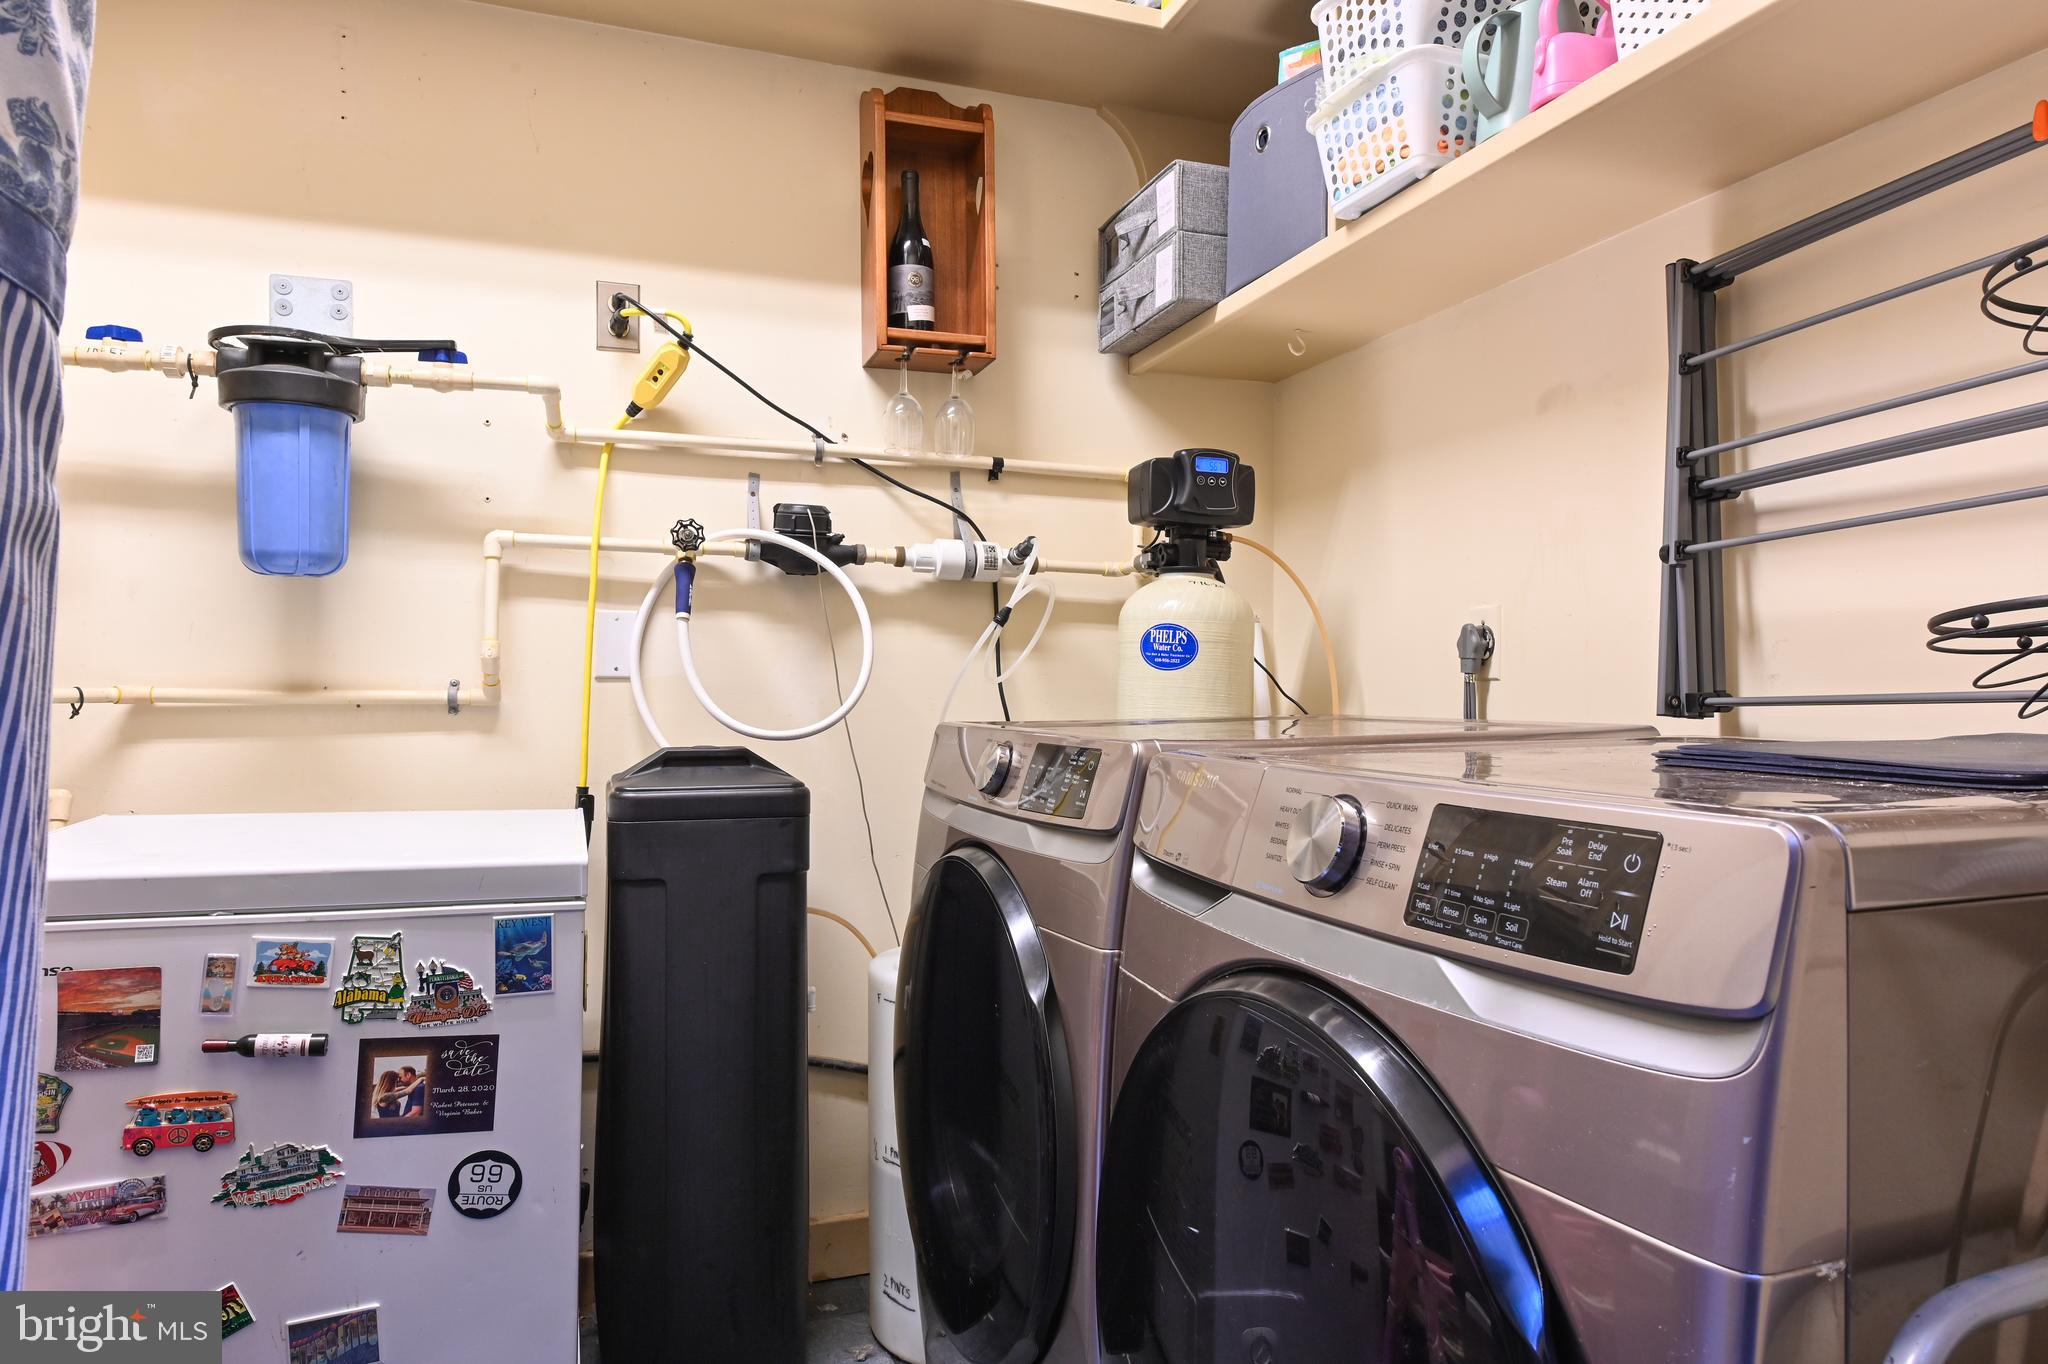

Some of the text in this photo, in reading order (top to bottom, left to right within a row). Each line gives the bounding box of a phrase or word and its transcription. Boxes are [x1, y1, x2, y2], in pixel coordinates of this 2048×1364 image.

[1150, 630, 1188, 644] PHELPS
[1153, 643, 1170, 651] Water
[1286, 786, 1302, 795] NORMAL
[1386, 802, 1418, 812] QUICK WASH
[1384, 824, 1412, 834] DELICATES
[1562, 836, 1573, 846] Pre
[1377, 841, 1406, 852] PERM PRESS
[1556, 847, 1572, 856] Soak
[1588, 841, 1608, 852] Delay
[1487, 854, 1498, 862] High
[1588, 852, 1602, 861] End
[1518, 860, 1534, 869] Heavy
[1366, 877, 1378, 886] SELF
[1420, 882, 1430, 891] Cold
[1546, 876, 1568, 888] Steam
[1578, 878, 1599, 889] Alarm
[1580, 888, 1592, 898] Off
[1416, 900, 1431, 910] Temp.
[1483, 897, 1495, 906] Spin
[1442, 906, 1459, 918] Rinse
[1507, 903, 1520, 912] Light
[497, 918, 550, 929] KEY WEST
[1473, 914, 1487, 925] Spin
[1505, 921, 1518, 932] Soil
[1598, 934, 1611, 943] Hold
[1618, 938, 1632, 948] Start
[335, 988, 387, 1007] Alabama
[462, 1053, 488, 1064] the
[448, 1062, 490, 1077] date
[432, 1086, 455, 1094] March
[472, 1084, 495, 1092] 2020
[470, 1164, 502, 1183] 66
[67, 1186, 117, 1202] MYRTLE
[461, 1196, 504, 1205] ROUTE
[883, 1273, 910, 1299] 2 PINTS
